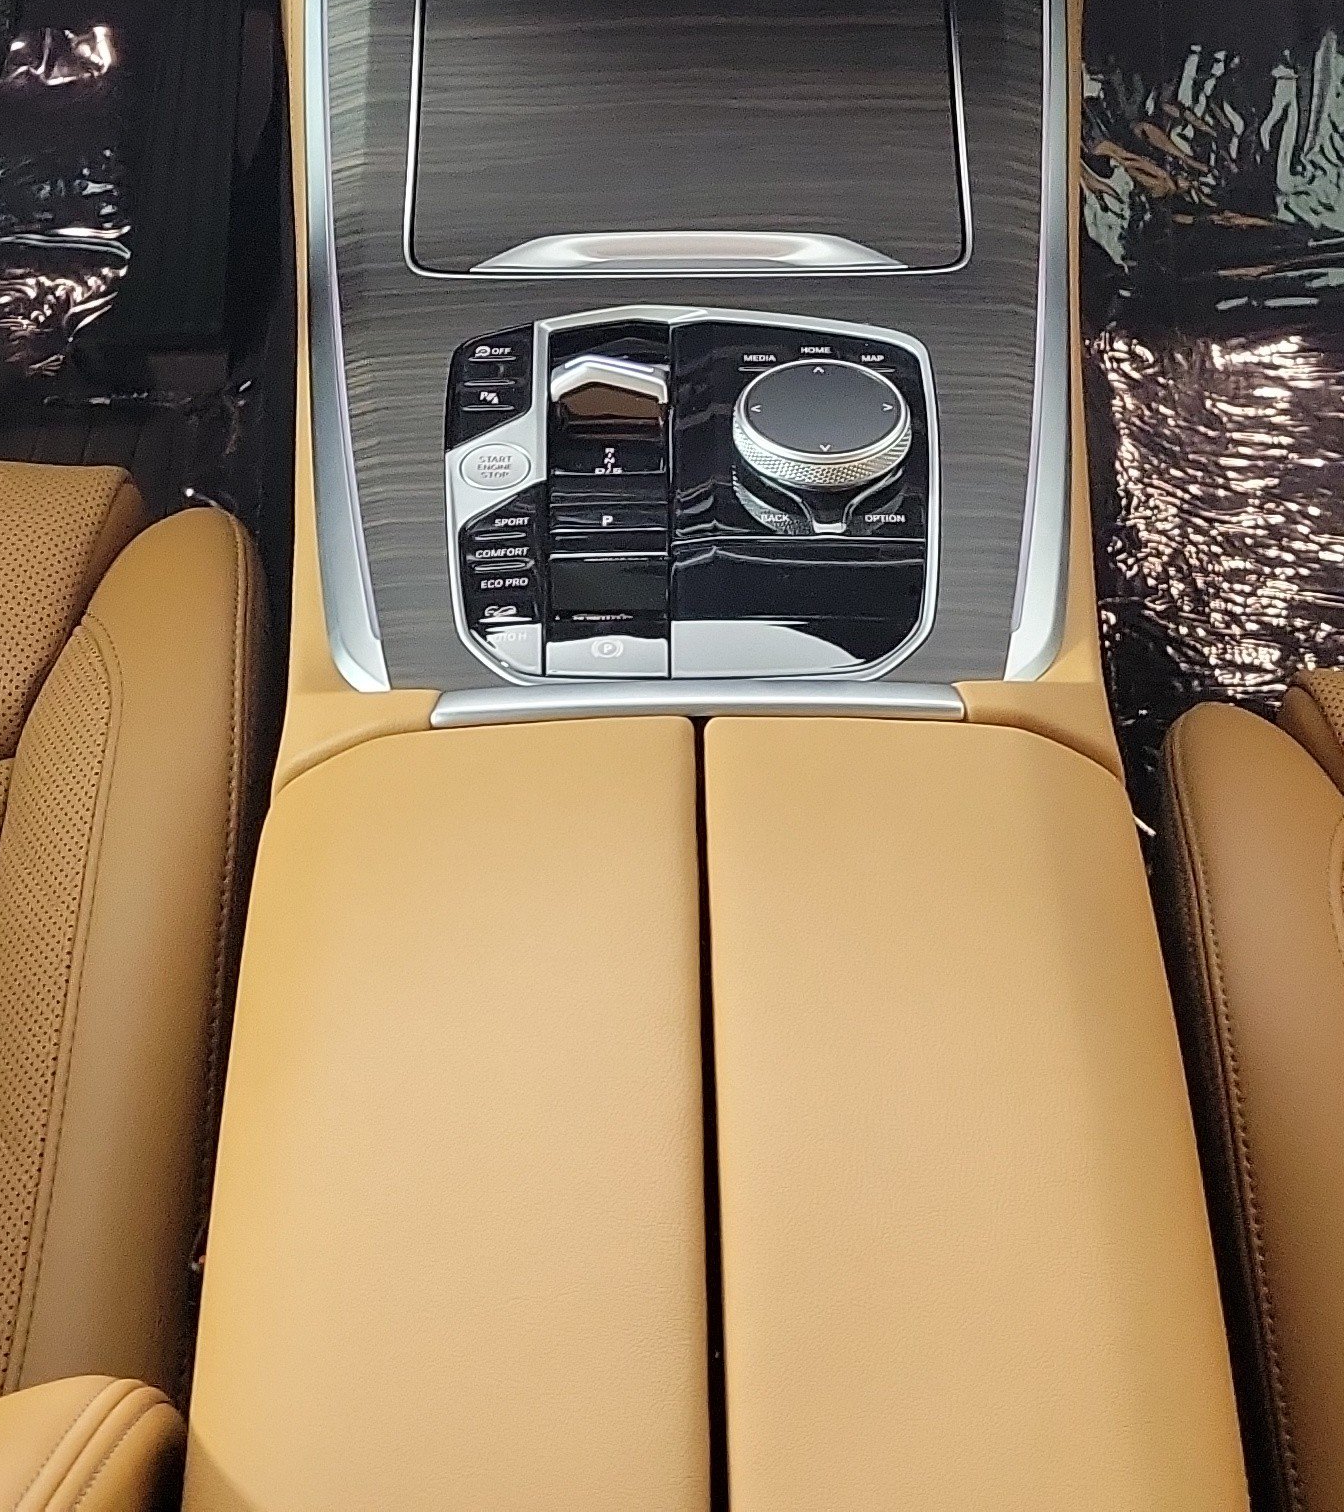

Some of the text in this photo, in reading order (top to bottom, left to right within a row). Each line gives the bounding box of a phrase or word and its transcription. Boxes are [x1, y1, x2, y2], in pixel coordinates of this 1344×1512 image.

[491, 347, 512, 356] OFF
[800, 346, 832, 355] HOME
[742, 354, 777, 363] MEDIA
[861, 354, 885, 363] MAP
[478, 455, 513, 464] START
[476, 463, 513, 472] ENGINE
[480, 471, 510, 480] STOP
[494, 516, 531, 528] SPORT
[601, 514, 614, 527] P
[864, 514, 906, 523] OPTION
[475, 546, 531, 559] COMFORT
[480, 577, 529, 589] ECO PRO
